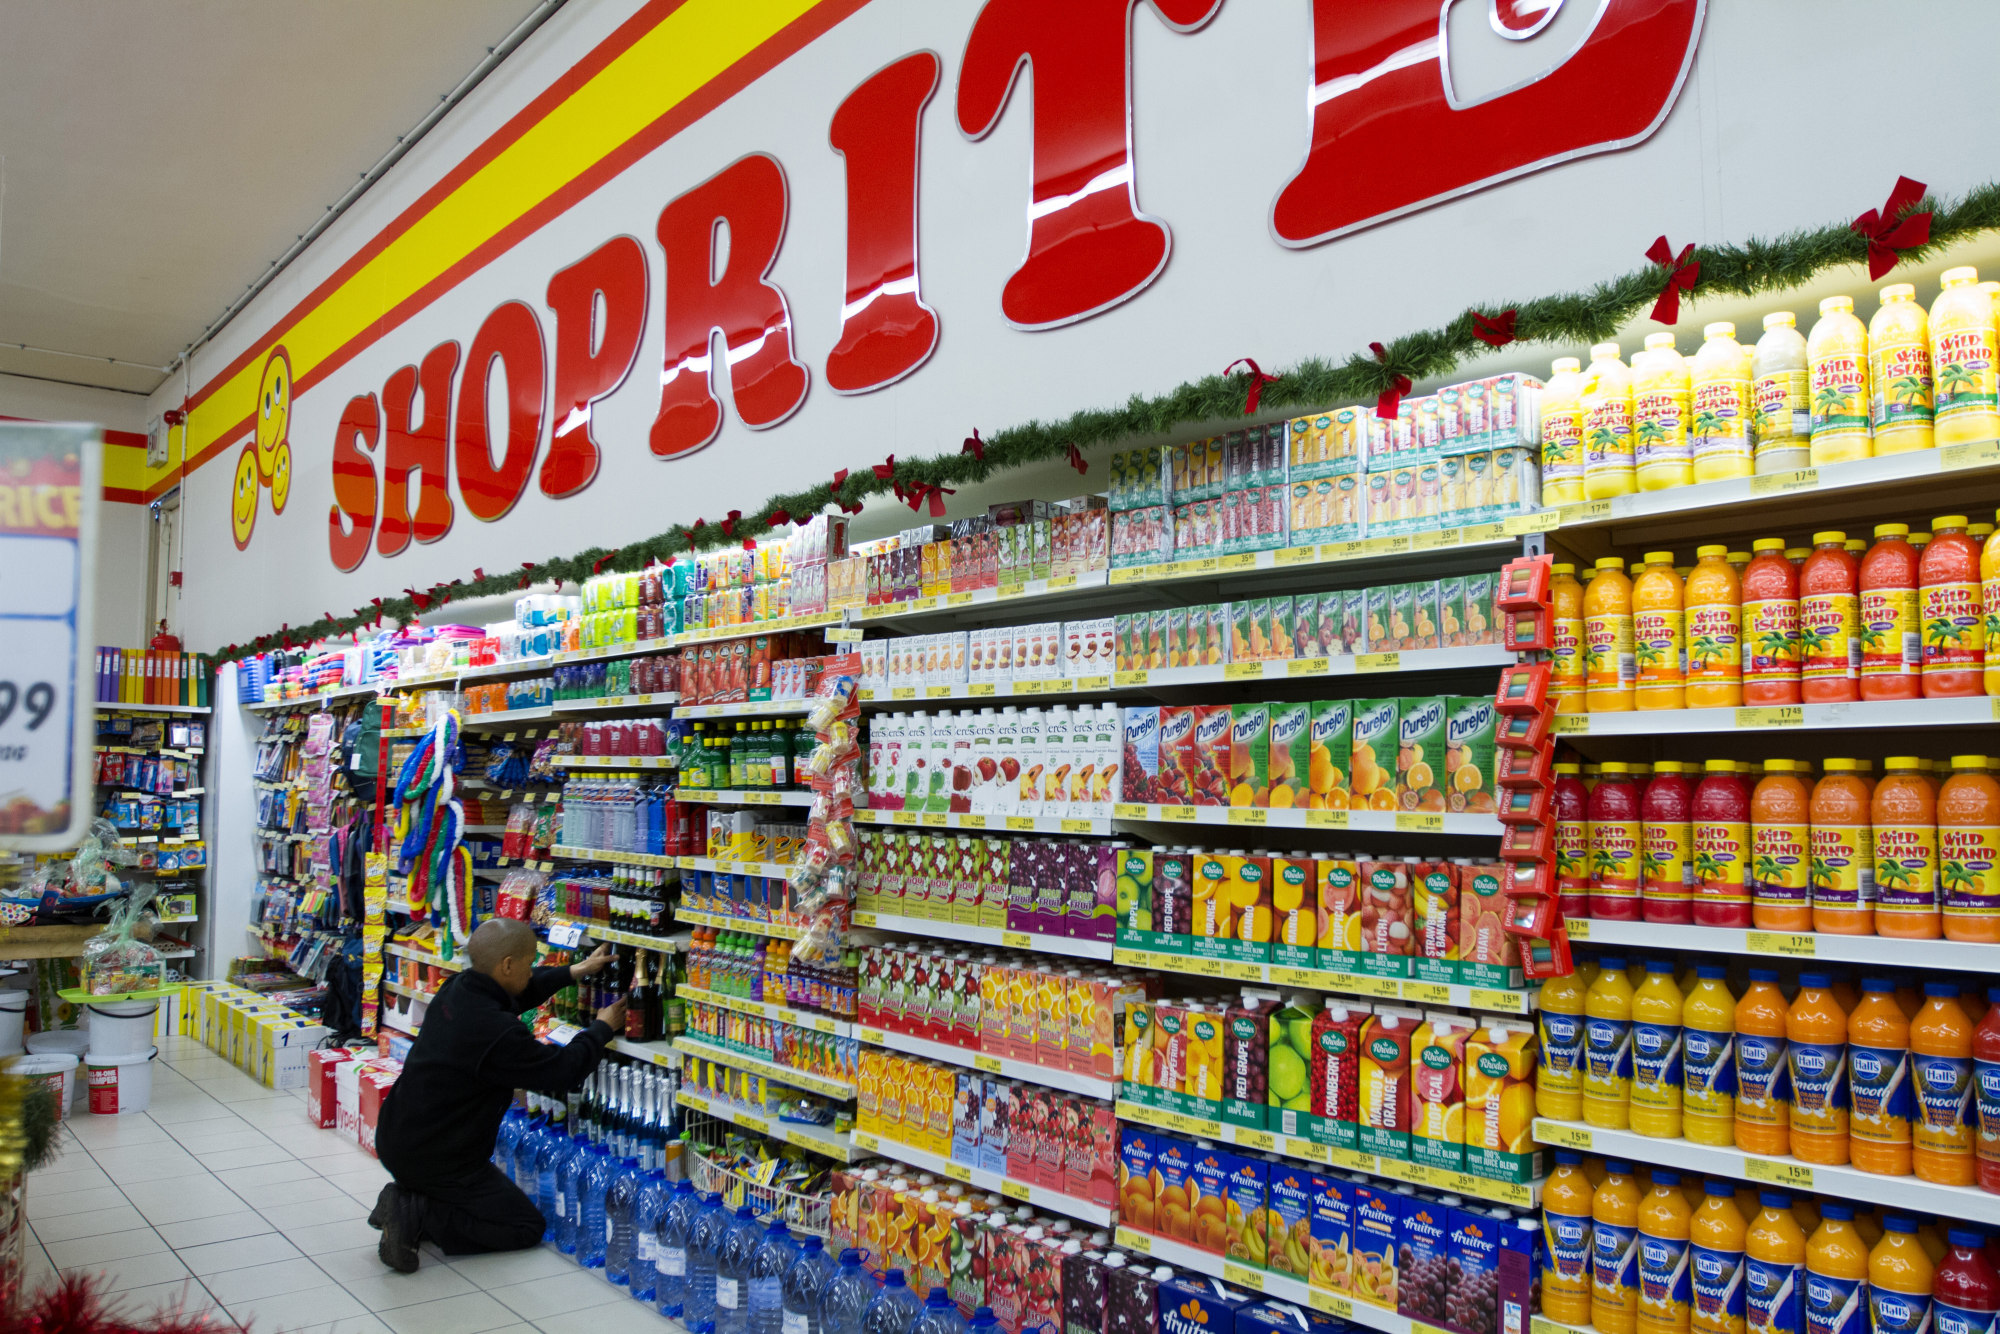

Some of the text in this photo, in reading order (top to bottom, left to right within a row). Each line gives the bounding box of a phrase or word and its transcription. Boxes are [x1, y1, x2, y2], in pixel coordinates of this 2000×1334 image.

[329, 0, 1708, 573] SHOPRITE
[1500, 569, 1510, 601] prochef
[1497, 673, 1510, 704] prochef
[1126, 712, 1157, 743] PureJoy
[1160, 713, 1192, 742] PureJoy
[1196, 712, 1229, 742] PureJoy
[1233, 711, 1265, 742] PureJoy
[1272, 709, 1306, 742] PureJoy
[1313, 708, 1347, 741] PureJoy
[1355, 705, 1393, 741] PureJoy
[1402, 703, 1441, 740] PureJoy
[1450, 703, 1490, 740] PureJoy
[1126, 861, 1145, 871] Rhodes
[1164, 865, 1183, 873] Rhodes
[1204, 866, 1224, 875] Rhodes
[1241, 869, 1262, 878] Rhodes
[1284, 871, 1306, 880] Rhodes
[1329, 873, 1351, 882] Rhodes
[1372, 875, 1396, 885] Rhodes
[1426, 878, 1449, 888] Rhodes
[1474, 880, 1498, 890] Rhodes
[1129, 900, 1139, 928] APPLE
[1164, 887, 1174, 932] RED GRAPE
[1206, 899, 1217, 935] ORANGE
[1243, 905, 1254, 939] MANGO
[1288, 909, 1298, 944] MANGO
[1332, 899, 1345, 948] TROPICAL
[1426, 895, 1438, 957] STRAWBERRY
[1436, 911, 1447, 948] BANANA
[1377, 918, 1387, 952] LITCHI
[1477, 928, 1489, 961] GUAVA
[1520, 940, 1534, 975] prochef
[1134, 1014, 1148, 1023] Rhodes
[1163, 1020, 1180, 1030] Rhodes
[1196, 1026, 1214, 1035] Rhodes
[1234, 1023, 1255, 1033] Rhodes
[1552, 1024, 1575, 1035] Hall's
[1591, 1030, 1614, 1042] Hall's
[1321, 1035, 1346, 1047] Rhodes
[1372, 1043, 1398, 1056] Rhodes
[1638, 1035, 1661, 1047] Hall's
[1423, 1051, 1450, 1063] Rhodes
[1741, 1045, 1767, 1059] Hall's
[1169, 1038, 1179, 1089] GRAPEFRUIT
[1236, 1040, 1249, 1098] RED GRAPE
[1479, 1058, 1509, 1071] Rhodes
[1798, 1054, 1825, 1070] Hall's
[1855, 1059, 1881, 1072] Hall's
[1161, 1065, 1169, 1087] RUBY
[1198, 1064, 1207, 1097] PEACH
[1792, 1075, 1833, 1092] Smooth
[1927, 1068, 1957, 1082] Hall's
[1326, 1054, 1340, 1117] CRANBERRY
[1850, 1080, 1891, 1098] Smooth
[1369, 1079, 1384, 1125] MANGO
[1383, 1077, 1398, 1128] ORANGE
[1429, 1074, 1443, 1137] TROPICAL
[1920, 1092, 1963, 1107] Smooth
[1227, 1107, 1255, 1118] GRAPE JUICE
[1485, 1093, 1500, 1147] ORANGE
[1311, 1124, 1325, 1133] FRUIT
[1325, 1126, 1337, 1135] JUICE
[1338, 1128, 1354, 1138] BLEND
[1324, 1119, 1339, 1128] 100%
[1361, 1133, 1375, 1142] FRUIT
[1375, 1136, 1389, 1146] JUICE
[1390, 1139, 1407, 1149] BLEND
[1375, 1129, 1390, 1138] 100%
[1124, 1143, 1152, 1161] fruitree
[1413, 1143, 1428, 1154] FRUIT
[1429, 1146, 1443, 1157] JUICE
[1444, 1149, 1460, 1160] BLEND
[1427, 1139, 1443, 1149] 100%
[1158, 1152, 1189, 1170] fruitree
[1483, 1148, 1500, 1159] 100%
[1194, 1161, 1227, 1180] fruitree
[1468, 1154, 1484, 1164] FRUIT
[1485, 1157, 1498, 1168] JUICE
[1500, 1161, 1518, 1172] BLEND
[1230, 1171, 1263, 1190] fruitree
[1272, 1181, 1308, 1200] fruitree
[1314, 1193, 1351, 1213] fruitree
[1357, 1204, 1396, 1225] fruitree
[1403, 1217, 1444, 1238] fruitree
[1559, 1225, 1583, 1240] Hall's
[1451, 1229, 1495, 1251] fruitree
[1644, 1247, 1668, 1261] Hall's
[1697, 1260, 1722, 1273] Hall's
[1880, 1302, 1910, 1318] Hall's
